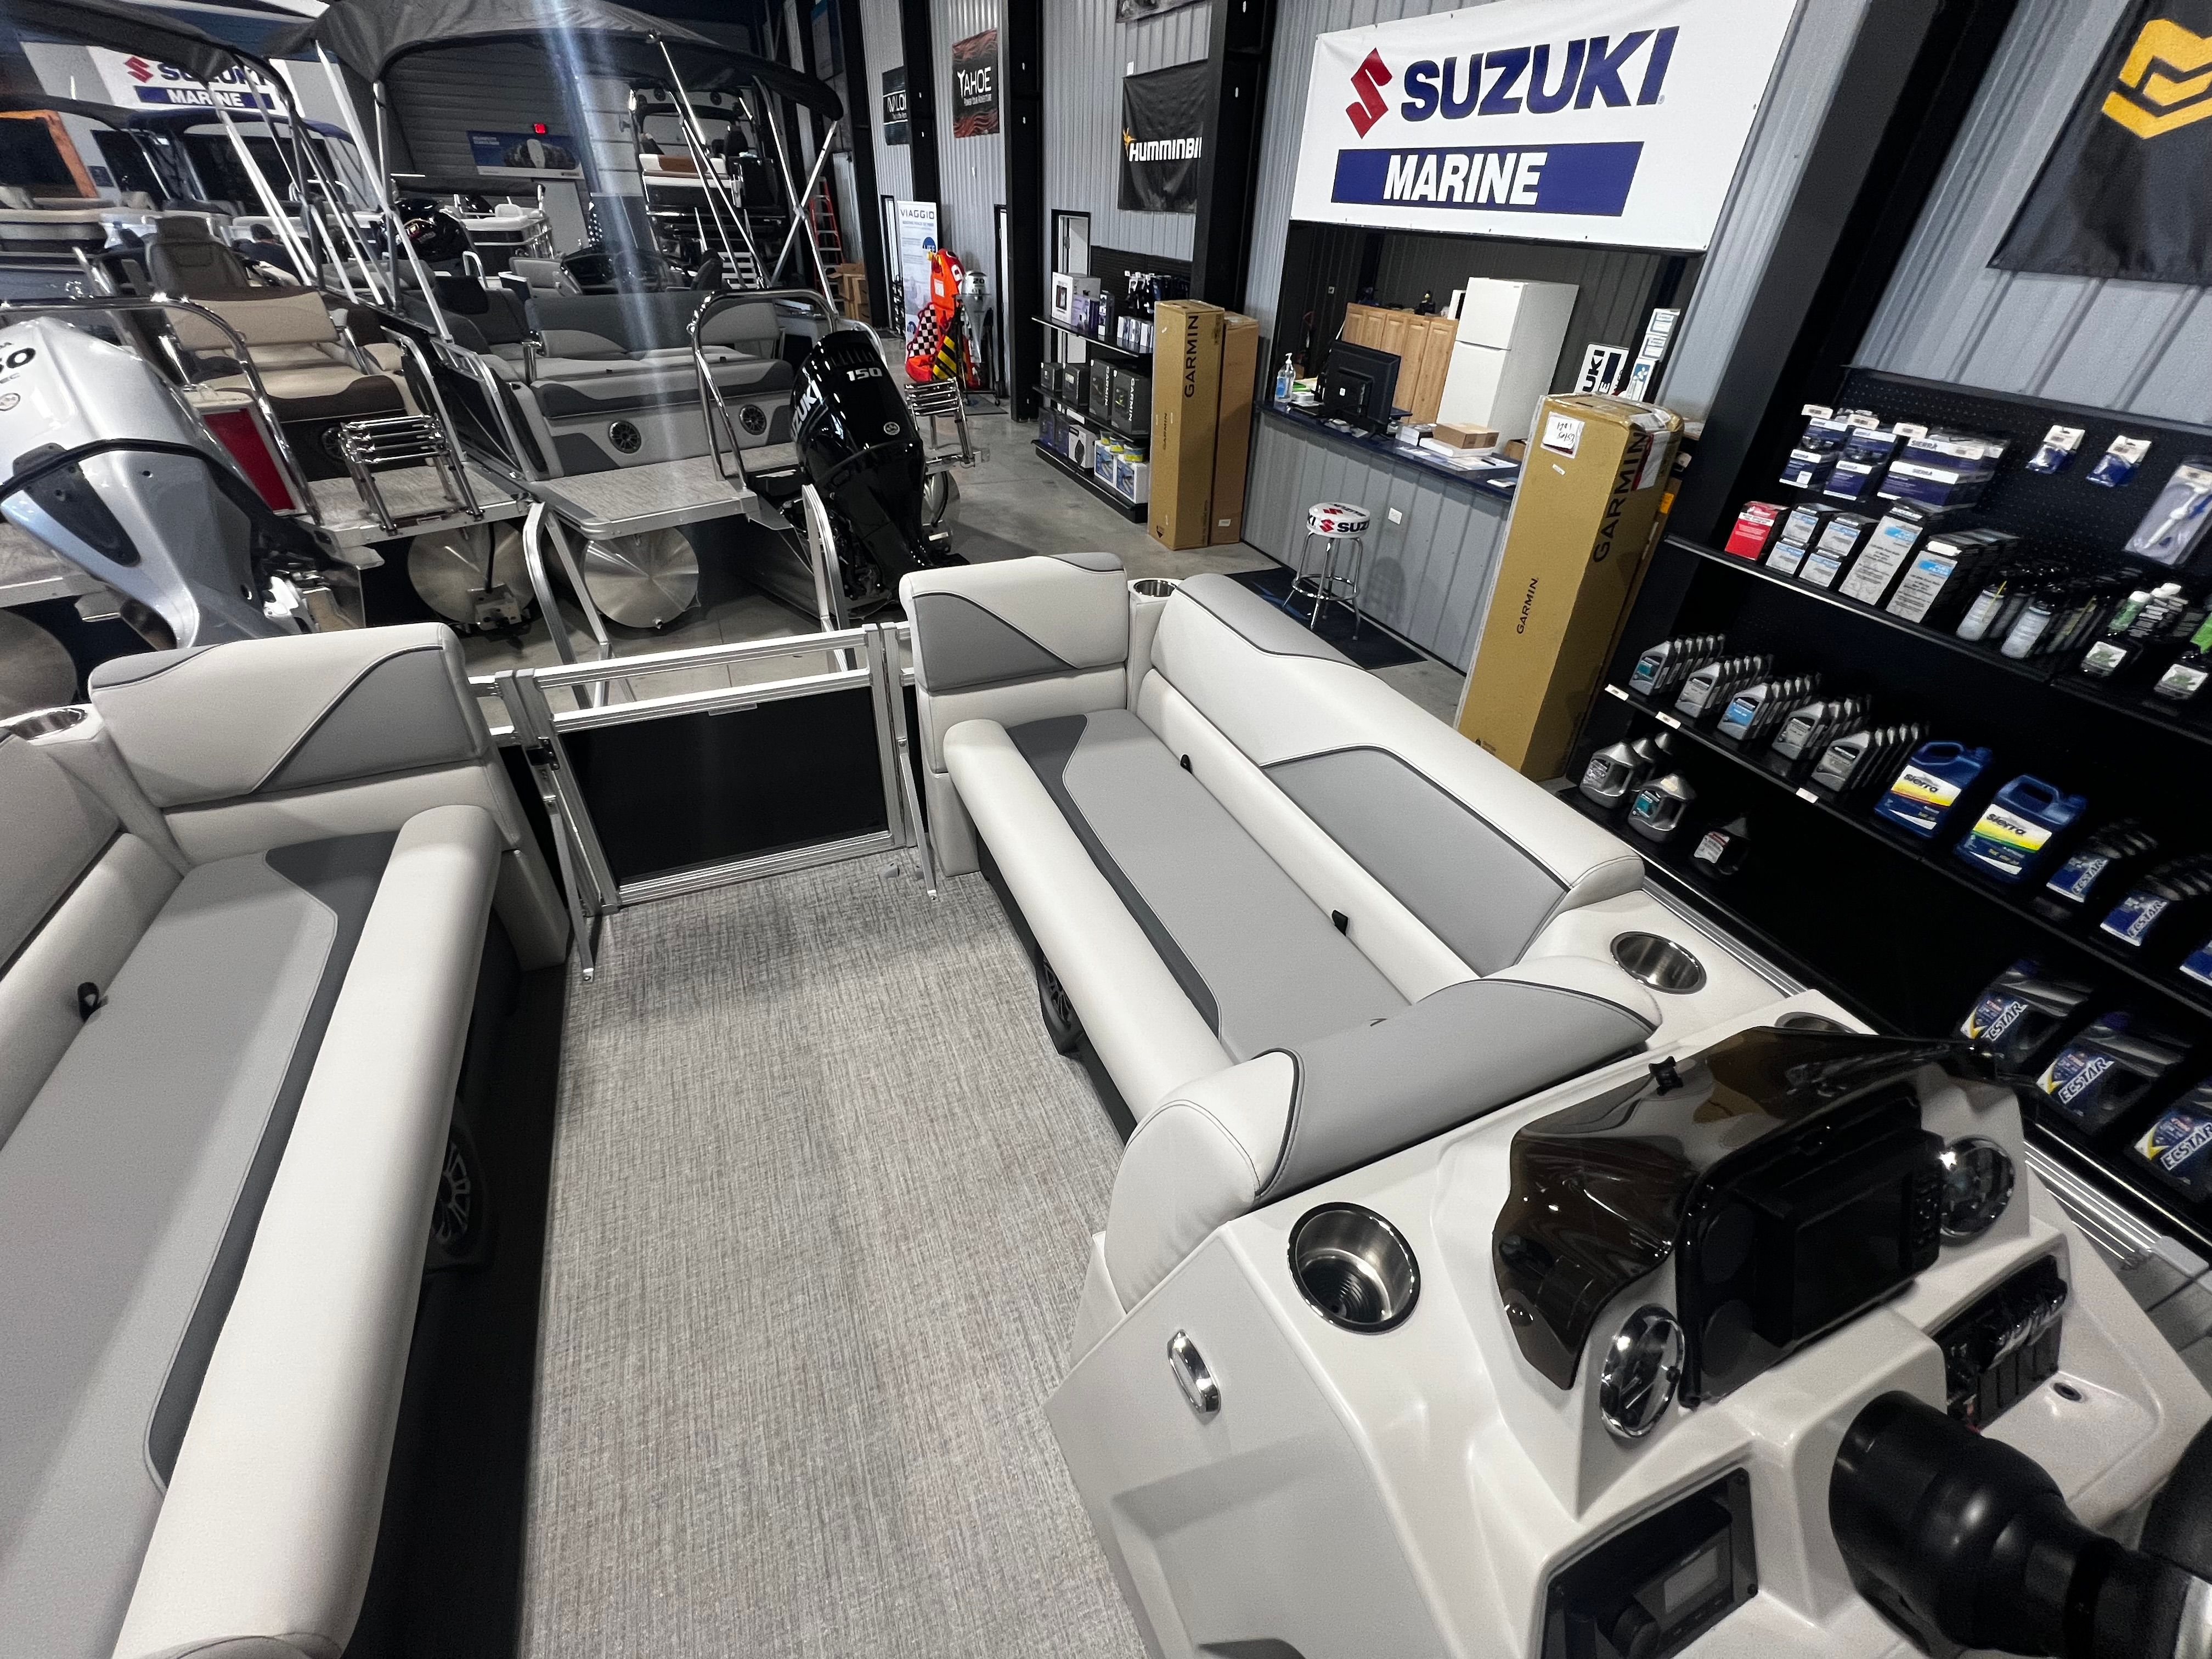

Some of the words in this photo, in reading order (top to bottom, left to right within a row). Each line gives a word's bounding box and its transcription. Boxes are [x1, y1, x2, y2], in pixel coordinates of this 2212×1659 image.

[1401, 25, 1680, 122] SUZUKI
[166, 88, 245, 108] MARNE
[1383, 151, 1548, 206] MARINE
[900, 208, 935, 219] VIAGGIO
[846, 367, 883, 382] 150
[1184, 315, 1199, 398] GARMIN
[1582, 349, 1605, 392] UKI
[1593, 431, 1649, 563] GARMIN
[1516, 578, 1538, 634] GARMIN
[1904, 774, 1940, 793] sierra
[1986, 813, 2027, 837] sierra
[1984, 1001, 2023, 1041] CSTAR
[2058, 1057, 2108, 1102] ECSTAR
